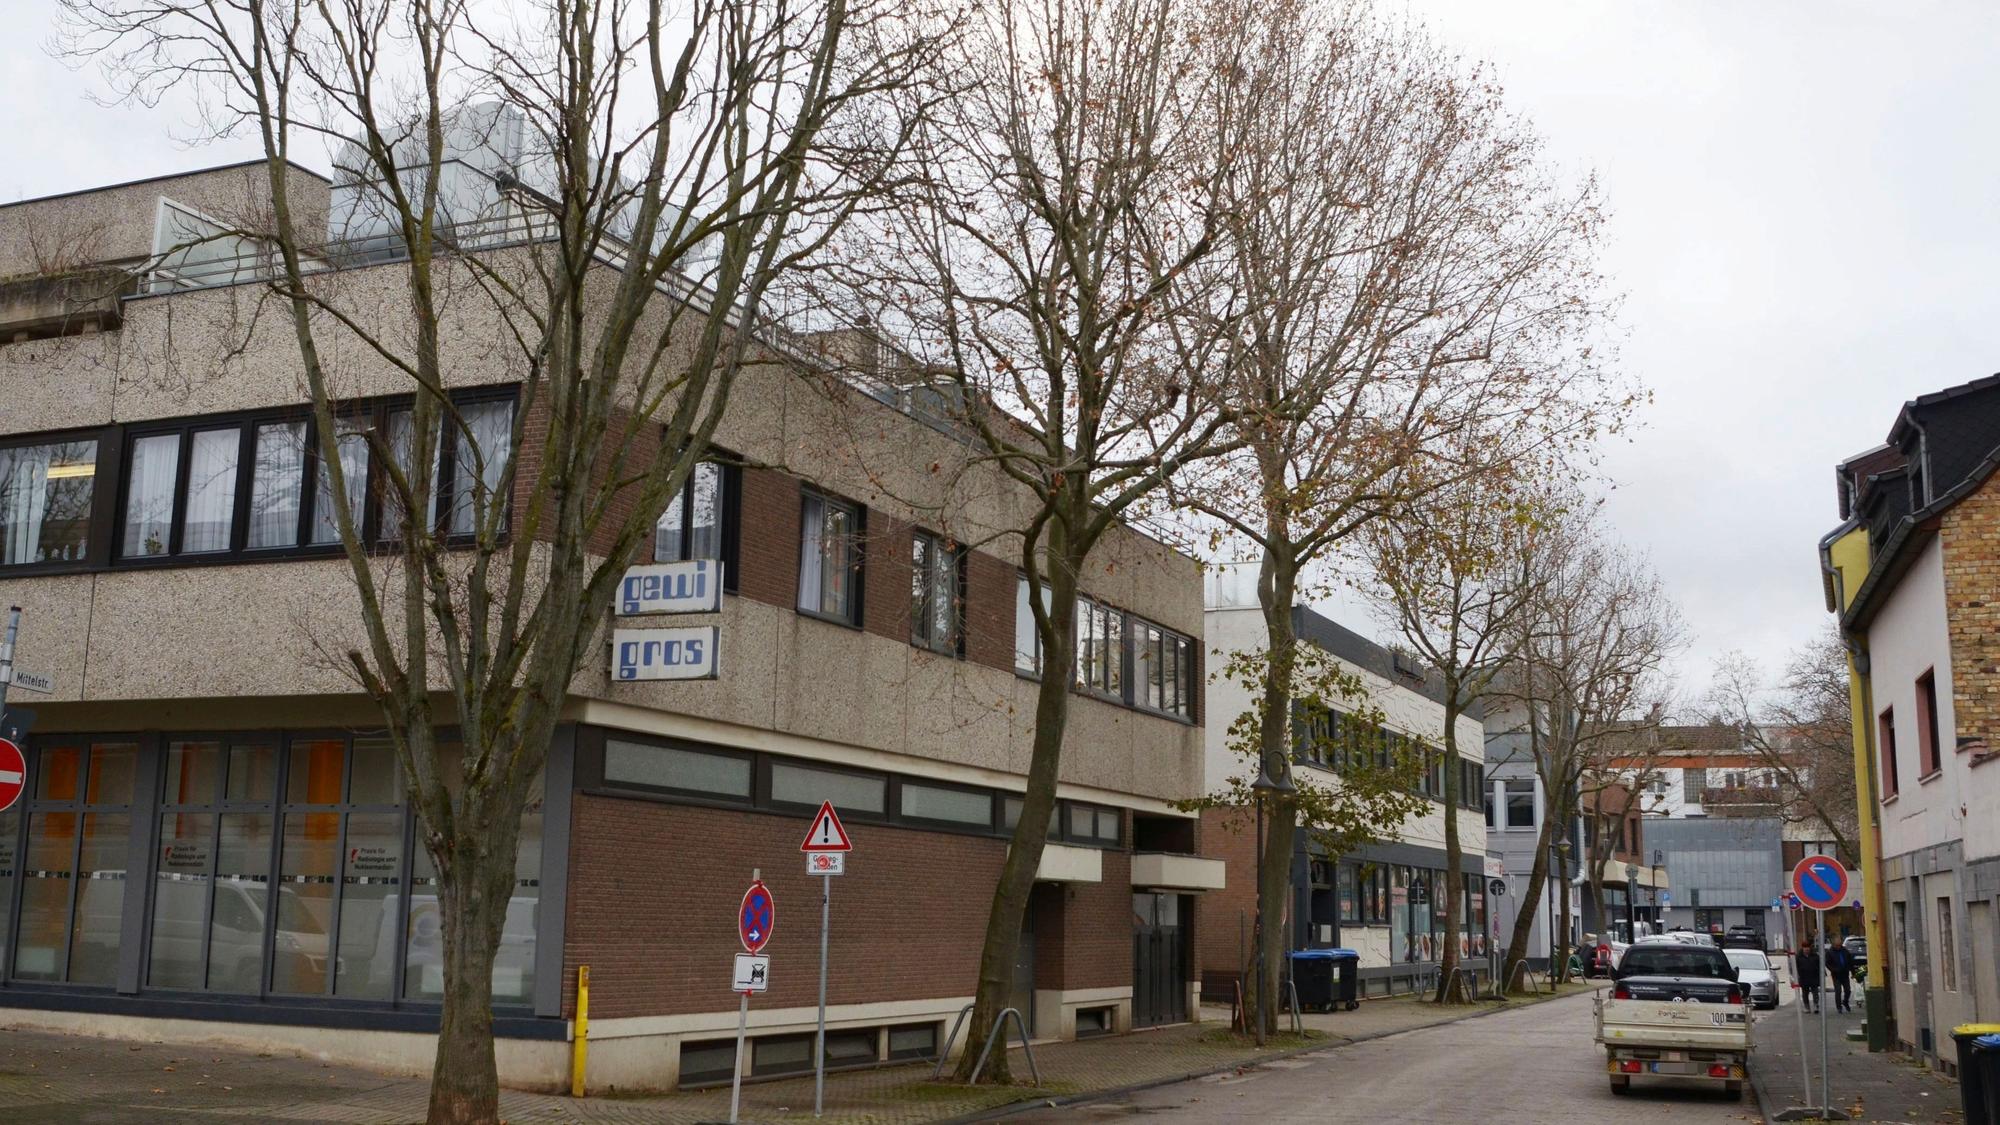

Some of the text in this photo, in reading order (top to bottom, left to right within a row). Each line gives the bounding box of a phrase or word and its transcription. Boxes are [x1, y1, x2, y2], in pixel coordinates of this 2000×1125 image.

[623, 560, 707, 613] gewi
[620, 640, 703, 679] gros
[17, 672, 49, 688] Mittelstr.
[1711, 1012, 1725, 1023] 100
